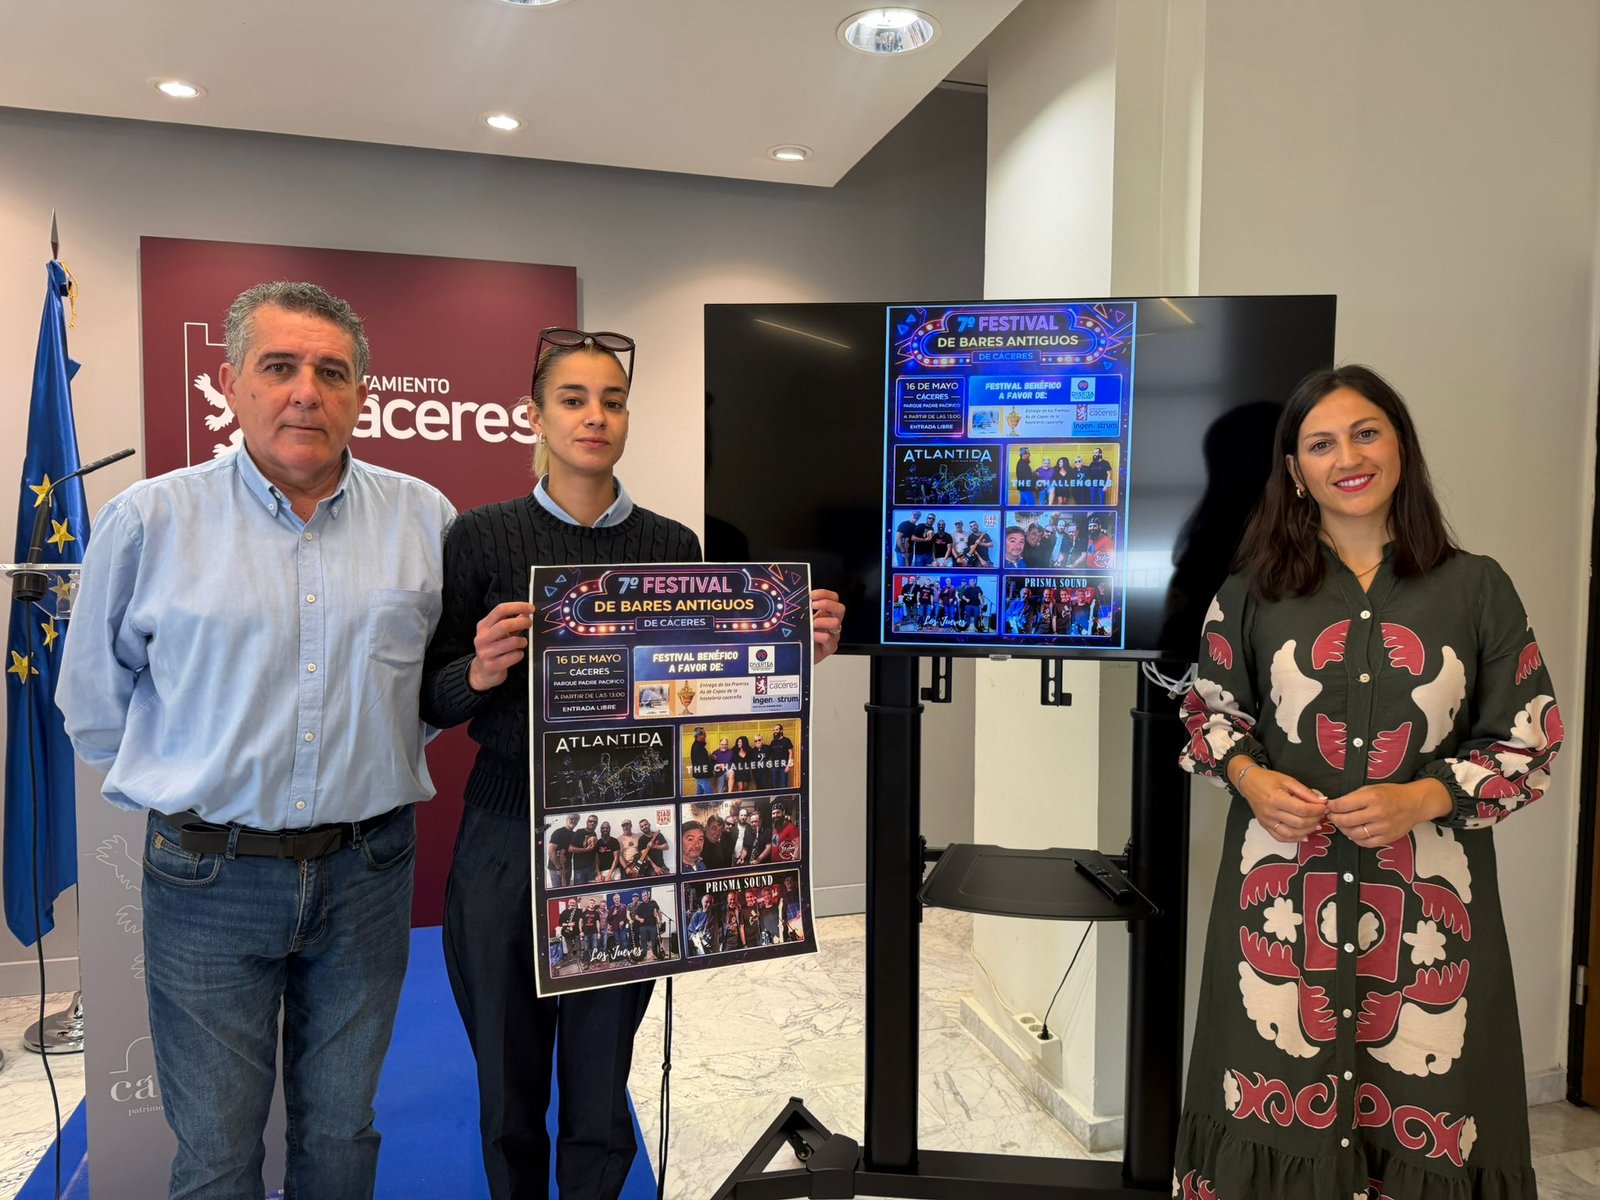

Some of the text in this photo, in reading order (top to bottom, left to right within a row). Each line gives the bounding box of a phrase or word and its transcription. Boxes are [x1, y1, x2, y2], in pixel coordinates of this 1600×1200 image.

[979, 315, 1059, 332] FESTIVAL
[937, 335, 1079, 348] DE BARES ANTIGUOS
[979, 353, 990, 361] DE
[363, 375, 450, 394] TAMIENTO
[917, 382, 930, 390] DE
[932, 382, 959, 390] MAYO
[985, 380, 1062, 390] FESTIVAL BENÉFICO
[998, 391, 1048, 400] A FAVOR DE:
[352, 394, 537, 444] áceres
[903, 449, 992, 462] ATLANTIDA
[1011, 479, 1112, 487] THE CHALLENGERS
[618, 576, 733, 594] 7º FESTIVAL
[1024, 578, 1088, 588] PRISMA SOUND
[594, 599, 754, 613] DE BARES ANTIGUOS
[644, 616, 706, 627] DE CÁCERES
[924, 615, 967, 627] Los Jueves
[556, 654, 621, 665] 16 DE MAYO
[652, 649, 738, 663] FESTIVAL BENÉFICO
[668, 662, 724, 673] A FAVOR DE:
[555, 732, 664, 754] ATLANTIDA
[686, 759, 794, 774] THE CHALLENGERS
[706, 875, 773, 893] PRISMA SOUND
[590, 944, 643, 962] Los Jueves
[128, 1105, 164, 1116] patrimo
